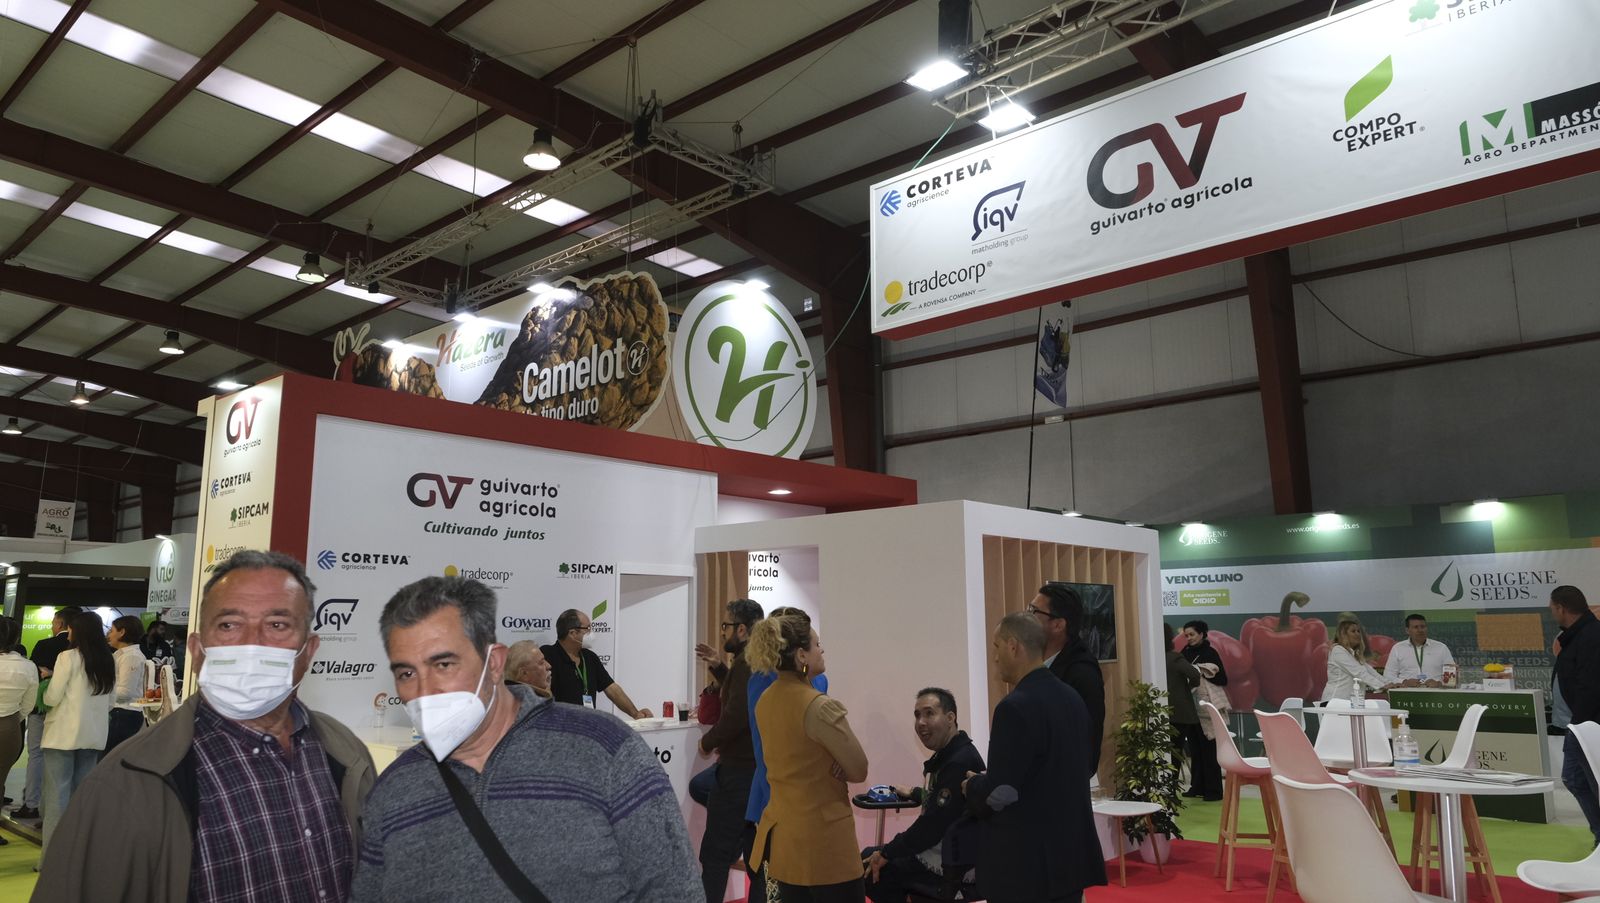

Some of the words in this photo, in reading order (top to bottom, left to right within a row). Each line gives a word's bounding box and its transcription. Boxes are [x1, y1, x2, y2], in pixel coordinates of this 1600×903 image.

[1333, 112, 1401, 143] COMPO
[1347, 121, 1417, 153] EXPERT
[1464, 149, 1502, 165] AGRO
[1511, 123, 1600, 152] DEPARTMEN
[906, 158, 993, 198] CORTEVA
[906, 188, 949, 209] agriscience
[981, 203, 1018, 232] iqv
[971, 238, 1009, 255] matholding
[1010, 233, 1029, 246] group
[908, 262, 986, 297] tradecorp
[924, 297, 948, 309] ROVENSA
[949, 290, 976, 303] COMPANY
[436, 328, 507, 368] Hazera
[522, 337, 625, 404] Camelot
[568, 397, 600, 421] duro
[220, 472, 252, 489] CORTEVA
[42, 507, 71, 517] AGRO
[238, 502, 269, 520] SIPCAM
[424, 520, 499, 538] Cultivando
[503, 526, 546, 541] juntos
[341, 552, 409, 566] CORTEVA
[461, 567, 509, 584] tradecorp
[571, 563, 614, 575] SIPCAM
[1165, 573, 1244, 585] VENTOLUNO
[1469, 570, 1557, 587] ORIGENE
[149, 589, 176, 603] GINEGAR
[748, 584, 773, 593] juntos
[1470, 586, 1530, 601] SEEDS
[323, 609, 352, 631] iqv
[502, 616, 551, 630] Gowan
[326, 660, 375, 676] Valagro
[1509, 656, 1550, 666] SEEDS
